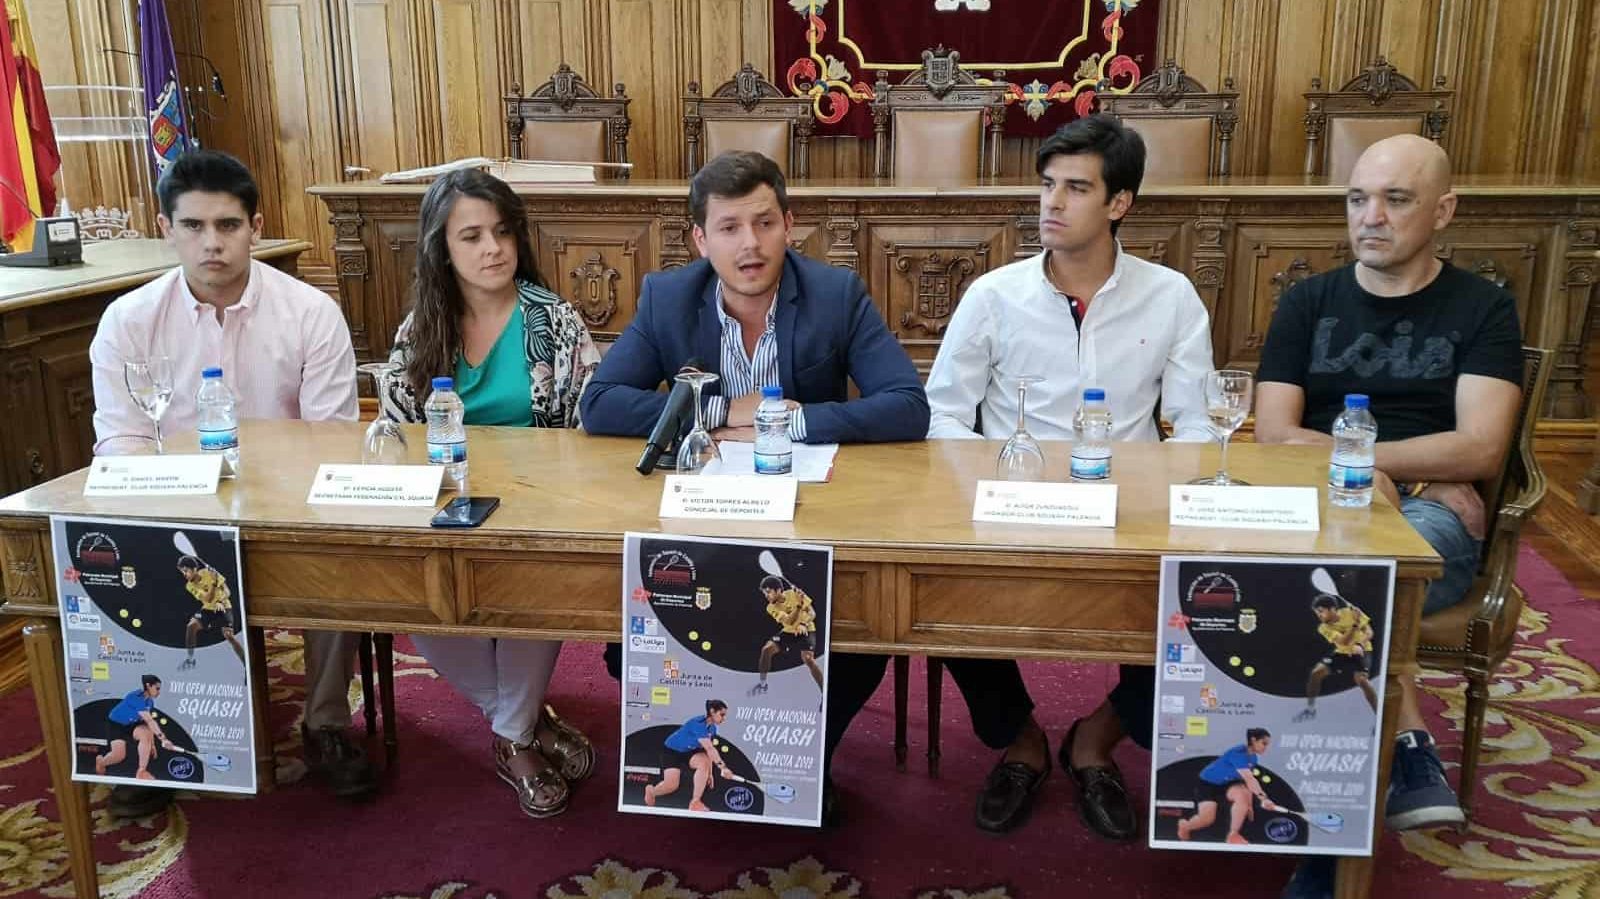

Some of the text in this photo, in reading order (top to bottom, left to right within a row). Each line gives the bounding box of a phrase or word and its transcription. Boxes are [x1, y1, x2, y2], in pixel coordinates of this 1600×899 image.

[659, 678, 686, 686] Castilla
[186, 683, 206, 696] OPEN
[207, 685, 243, 698] NACIONAL
[178, 698, 244, 719] SQUASH
[754, 708, 777, 722] OPEN
[777, 710, 817, 725] NACIONAL
[191, 724, 226, 738] PALENCIA
[743, 724, 816, 747] SQUASH
[754, 751, 794, 767] PALENCIA
[1286, 752, 1368, 776] SQUASH
[1299, 780, 1343, 795] PALENCIA
